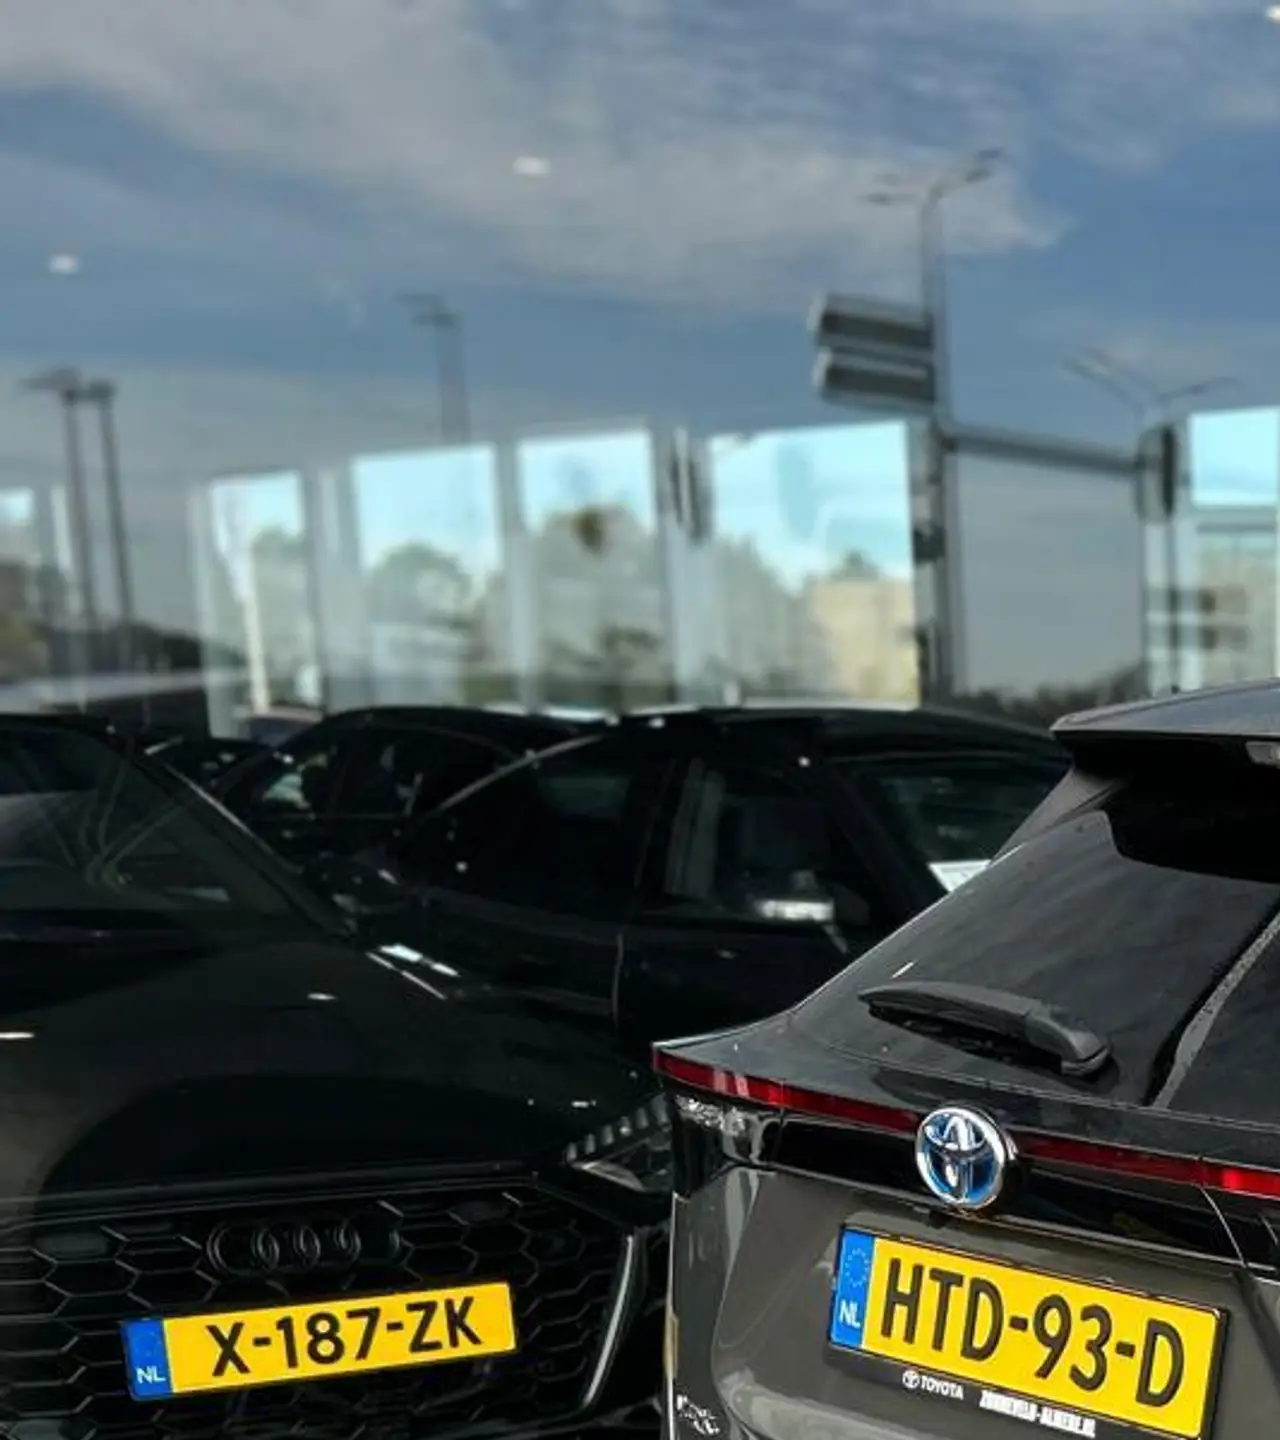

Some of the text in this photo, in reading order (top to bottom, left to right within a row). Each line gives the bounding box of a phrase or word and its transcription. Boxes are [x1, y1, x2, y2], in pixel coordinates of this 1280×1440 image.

[839, 1301, 862, 1330] NL
[205, 1296, 483, 1378] X-187-ZK
[880, 1257, 1186, 1408] HTD-93-D
[136, 1365, 166, 1385] NL
[920, 1374, 964, 1401] TOYOTA
